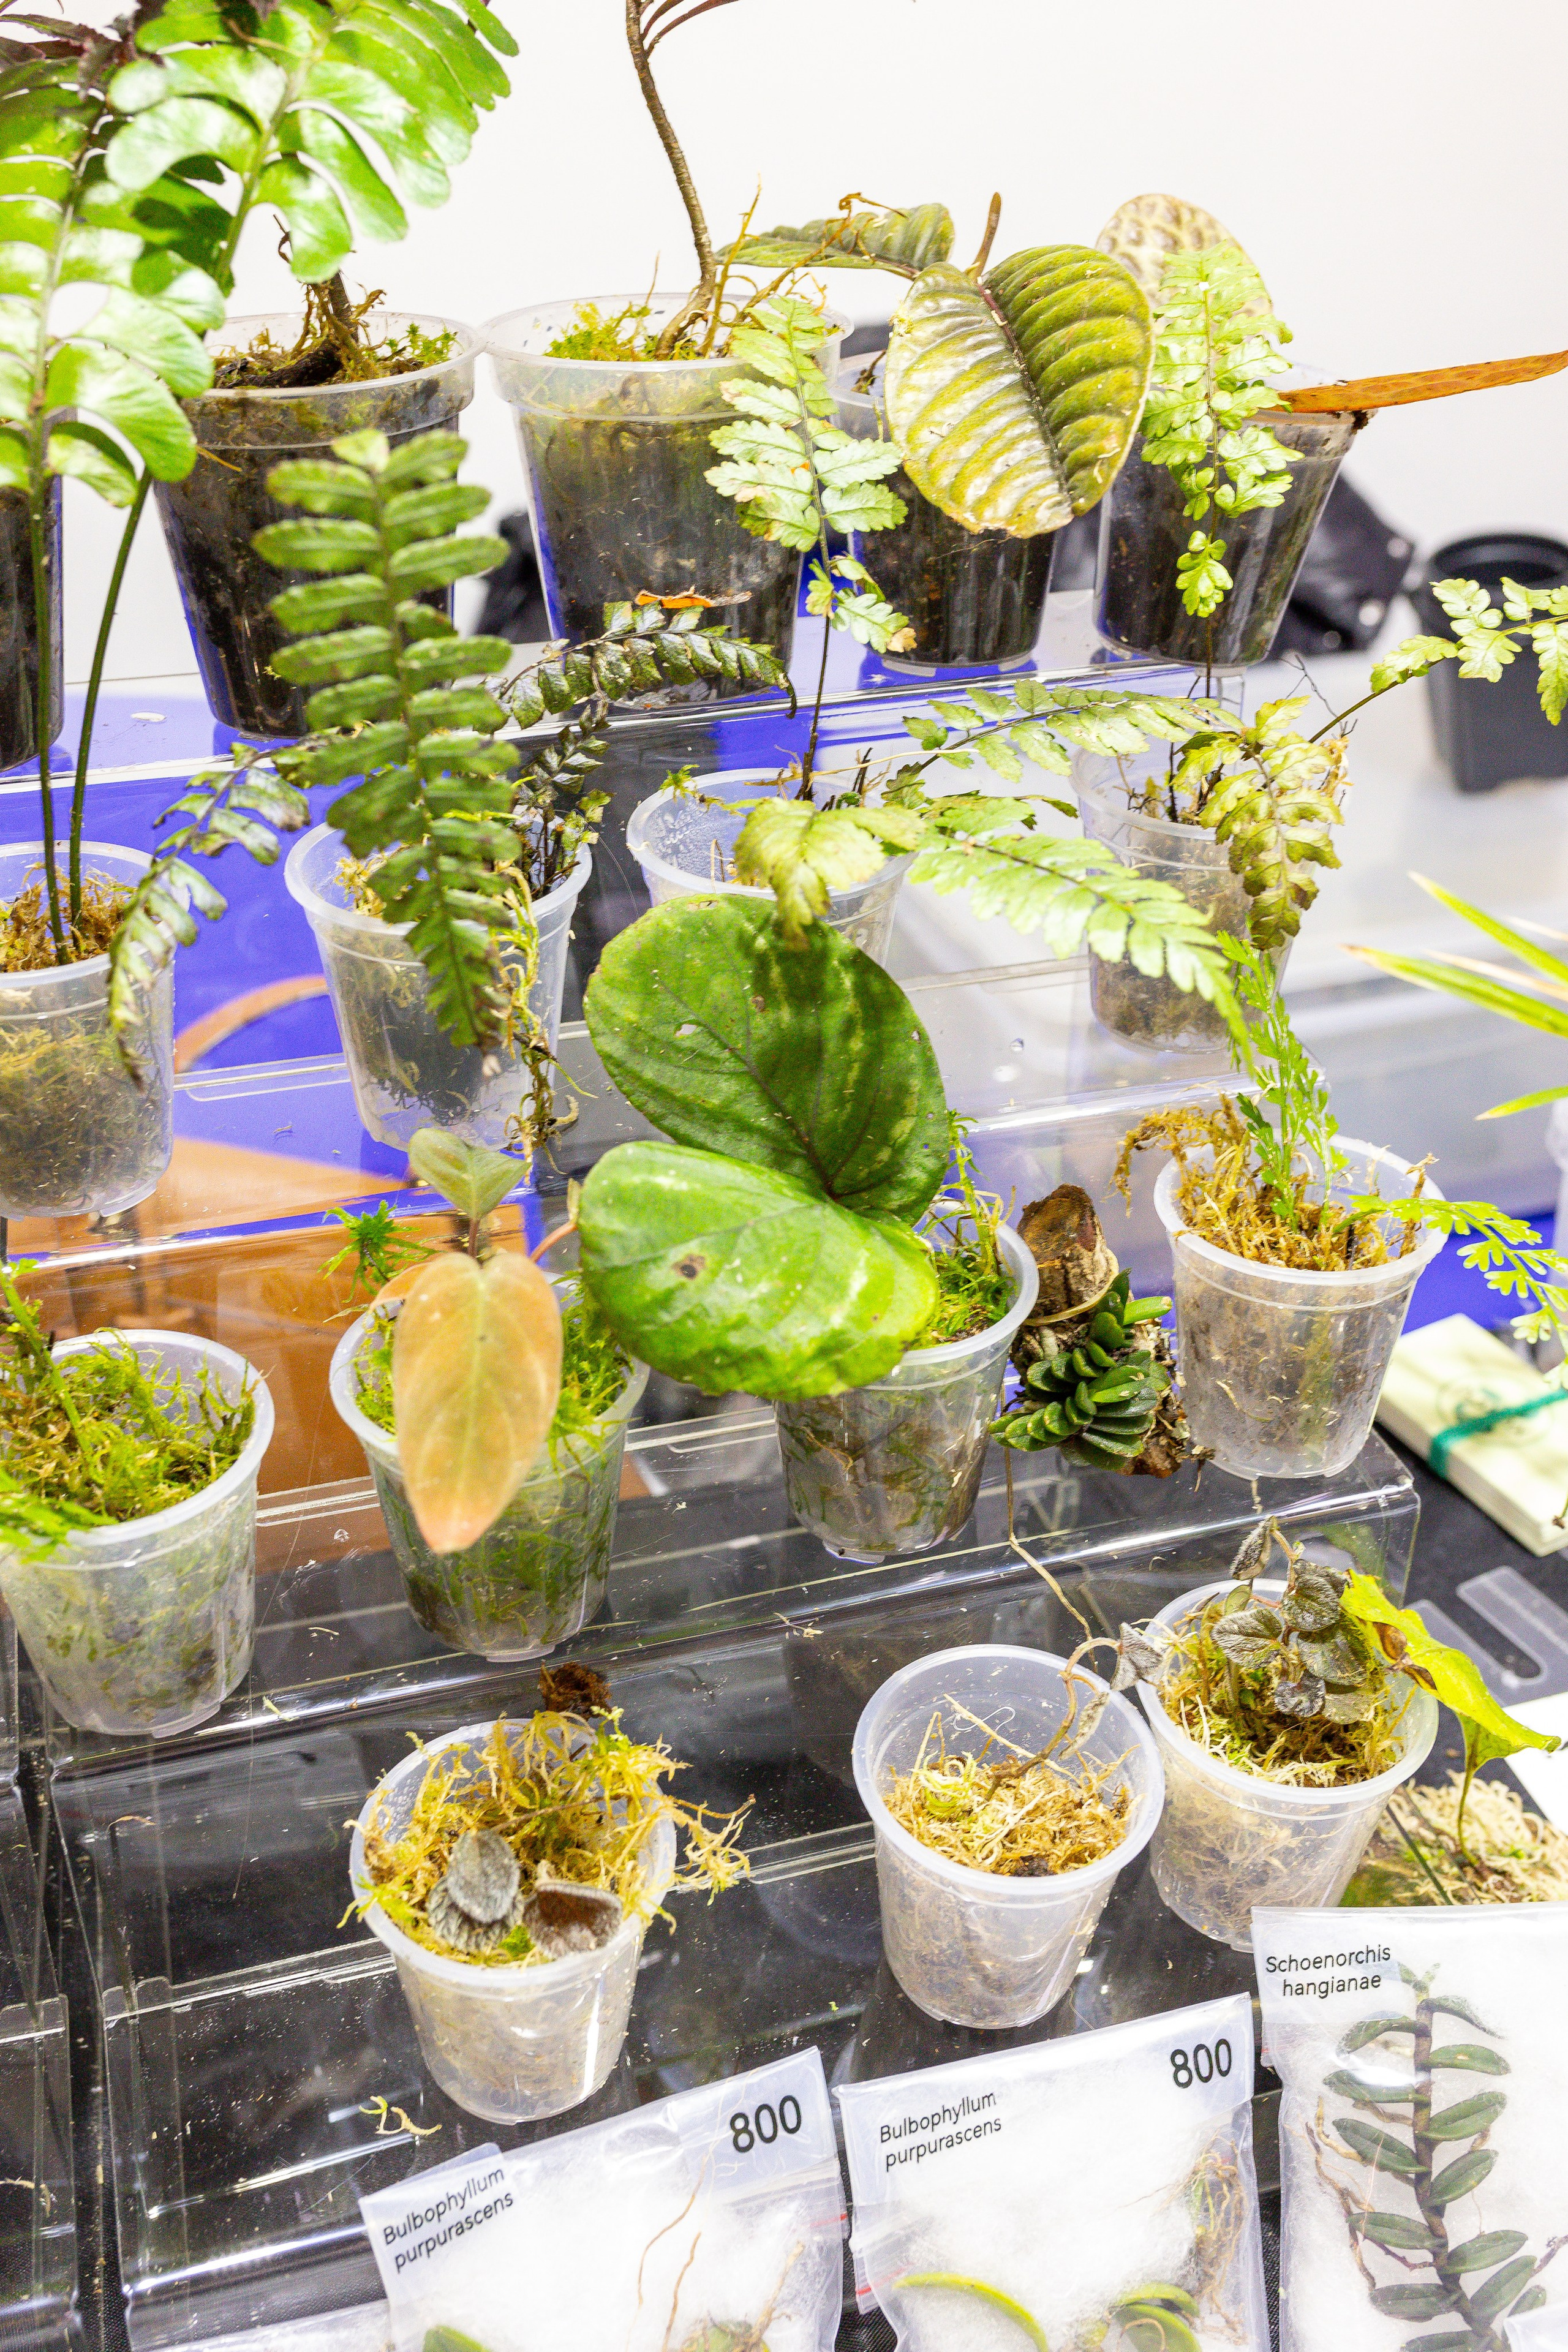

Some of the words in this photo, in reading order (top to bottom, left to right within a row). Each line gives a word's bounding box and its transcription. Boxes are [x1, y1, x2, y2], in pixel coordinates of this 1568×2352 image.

[1265, 1944, 1391, 1973] Schoenorchis
[1283, 1974, 1382, 1999] hangianae
[1170, 2038, 1232, 2089] 800
[729, 2095, 802, 2153] 800
[880, 2092, 997, 2143] Bulbophyllum
[886, 2118, 1001, 2173] purpurascens
[383, 2169, 505, 2245] Bulbophyllum
[394, 2193, 514, 2274] purpurascens
